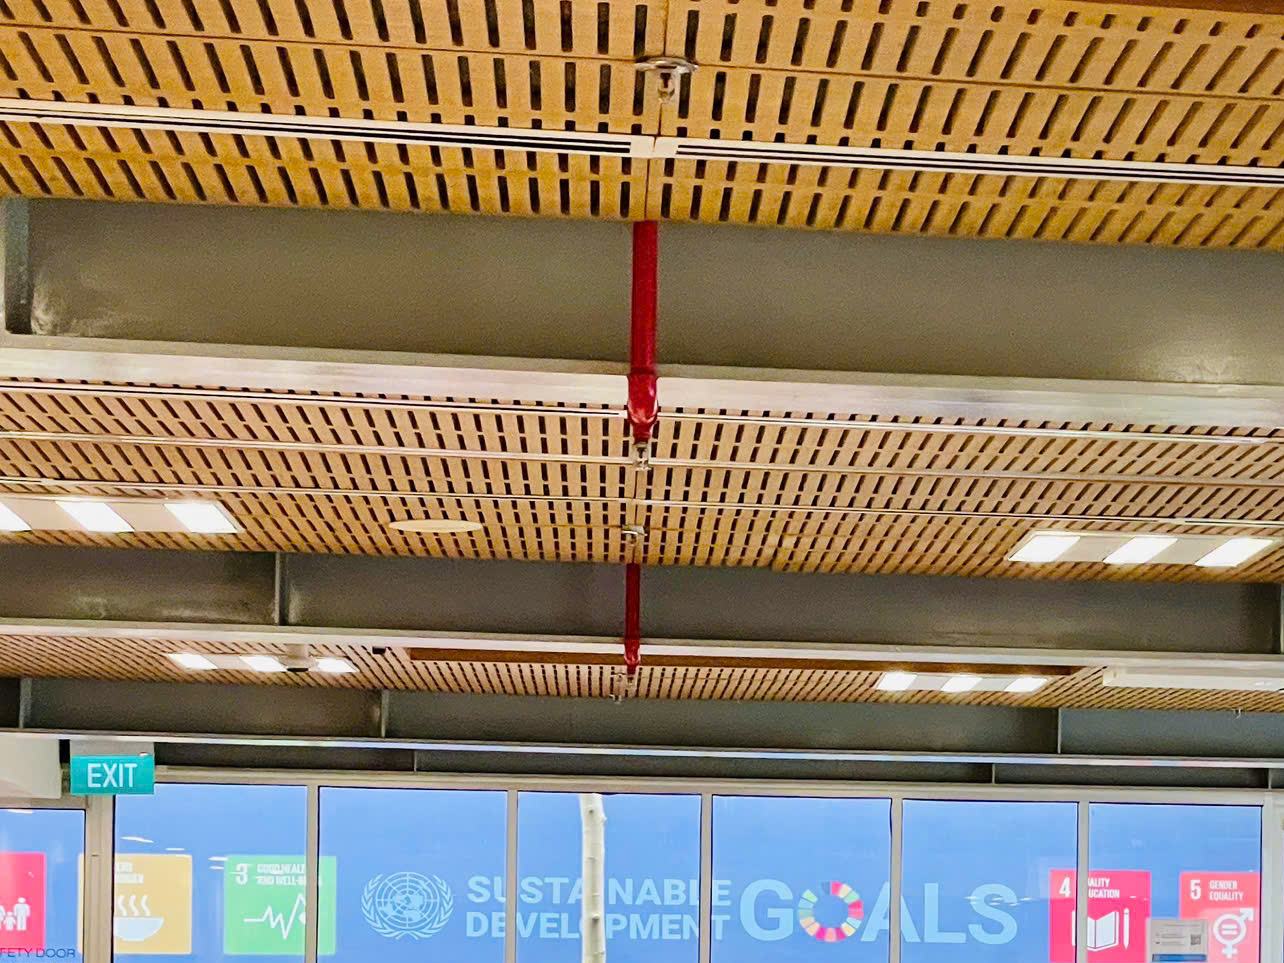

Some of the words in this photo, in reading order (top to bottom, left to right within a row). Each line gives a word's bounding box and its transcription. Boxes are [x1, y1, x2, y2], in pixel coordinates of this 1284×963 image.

[87, 763, 138, 789] EXIT
[236, 863, 248, 885] 3
[1088, 878, 1110, 888] ALITY
[467, 876, 732, 906] SUSTANABLE
[1059, 877, 1071, 898] 4
[1088, 889, 1120, 899] UCATION
[1190, 880, 1202, 900] 5
[1209, 881, 1238, 890] GENDER
[1209, 892, 1244, 902] EQUALITY
[740, 878, 1018, 945] GOALS
[466, 911, 731, 940] DEVELPMENT
[0, 947, 32, 958] FETY
[36, 948, 76, 958] DOOR
